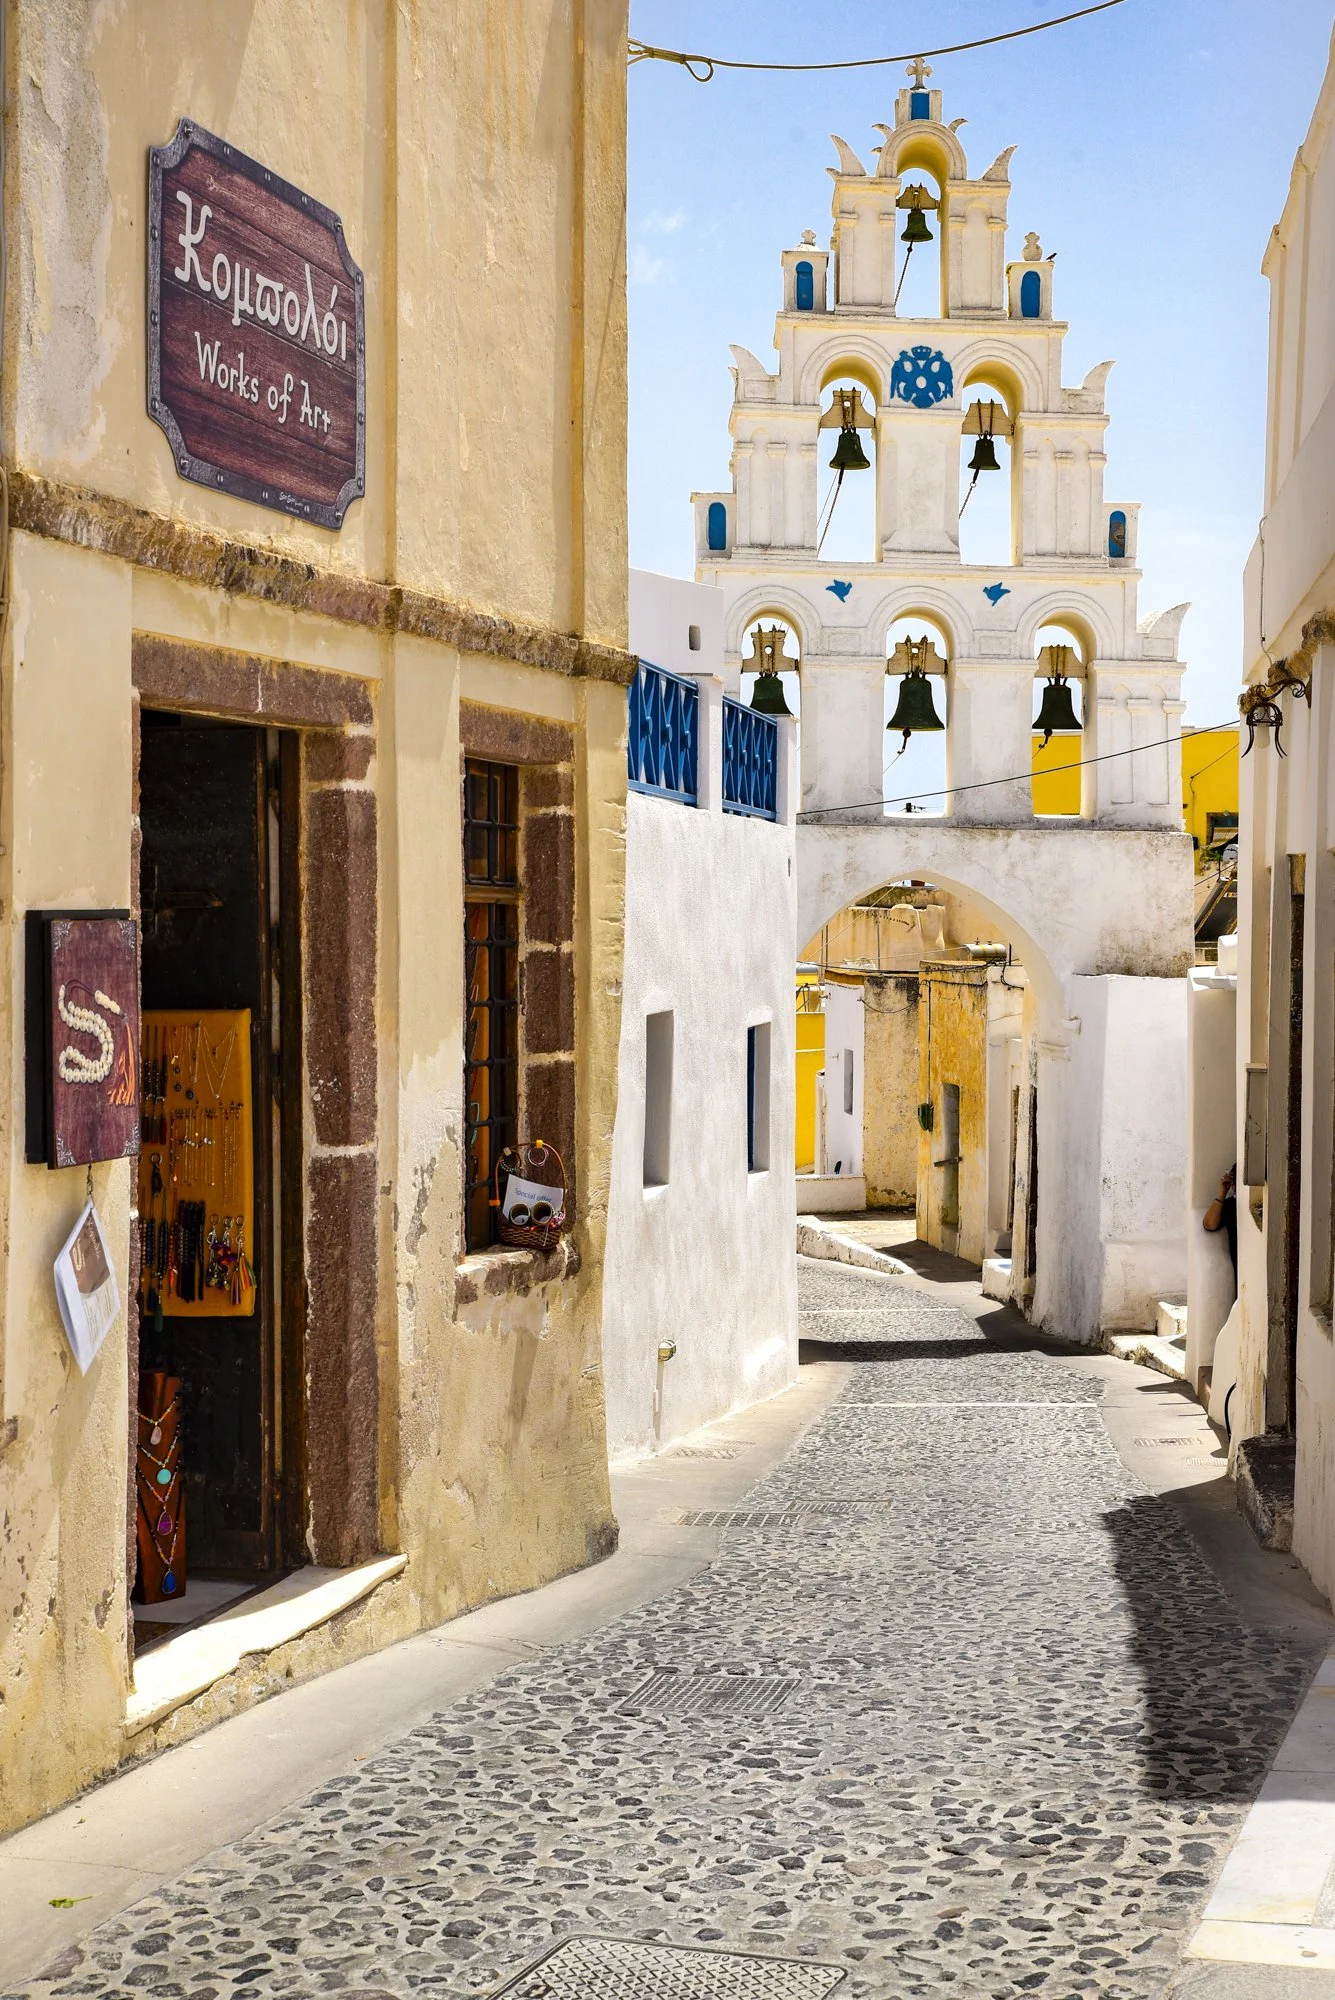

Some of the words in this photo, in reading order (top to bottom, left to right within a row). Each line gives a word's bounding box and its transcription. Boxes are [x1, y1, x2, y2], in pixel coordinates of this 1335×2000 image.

[194, 331, 259, 403] Works
[267, 373, 294, 424] of
[299, 379, 331, 433] Art
[514, 1187, 536, 1200] Special
[536, 1195, 552, 1203] offer
